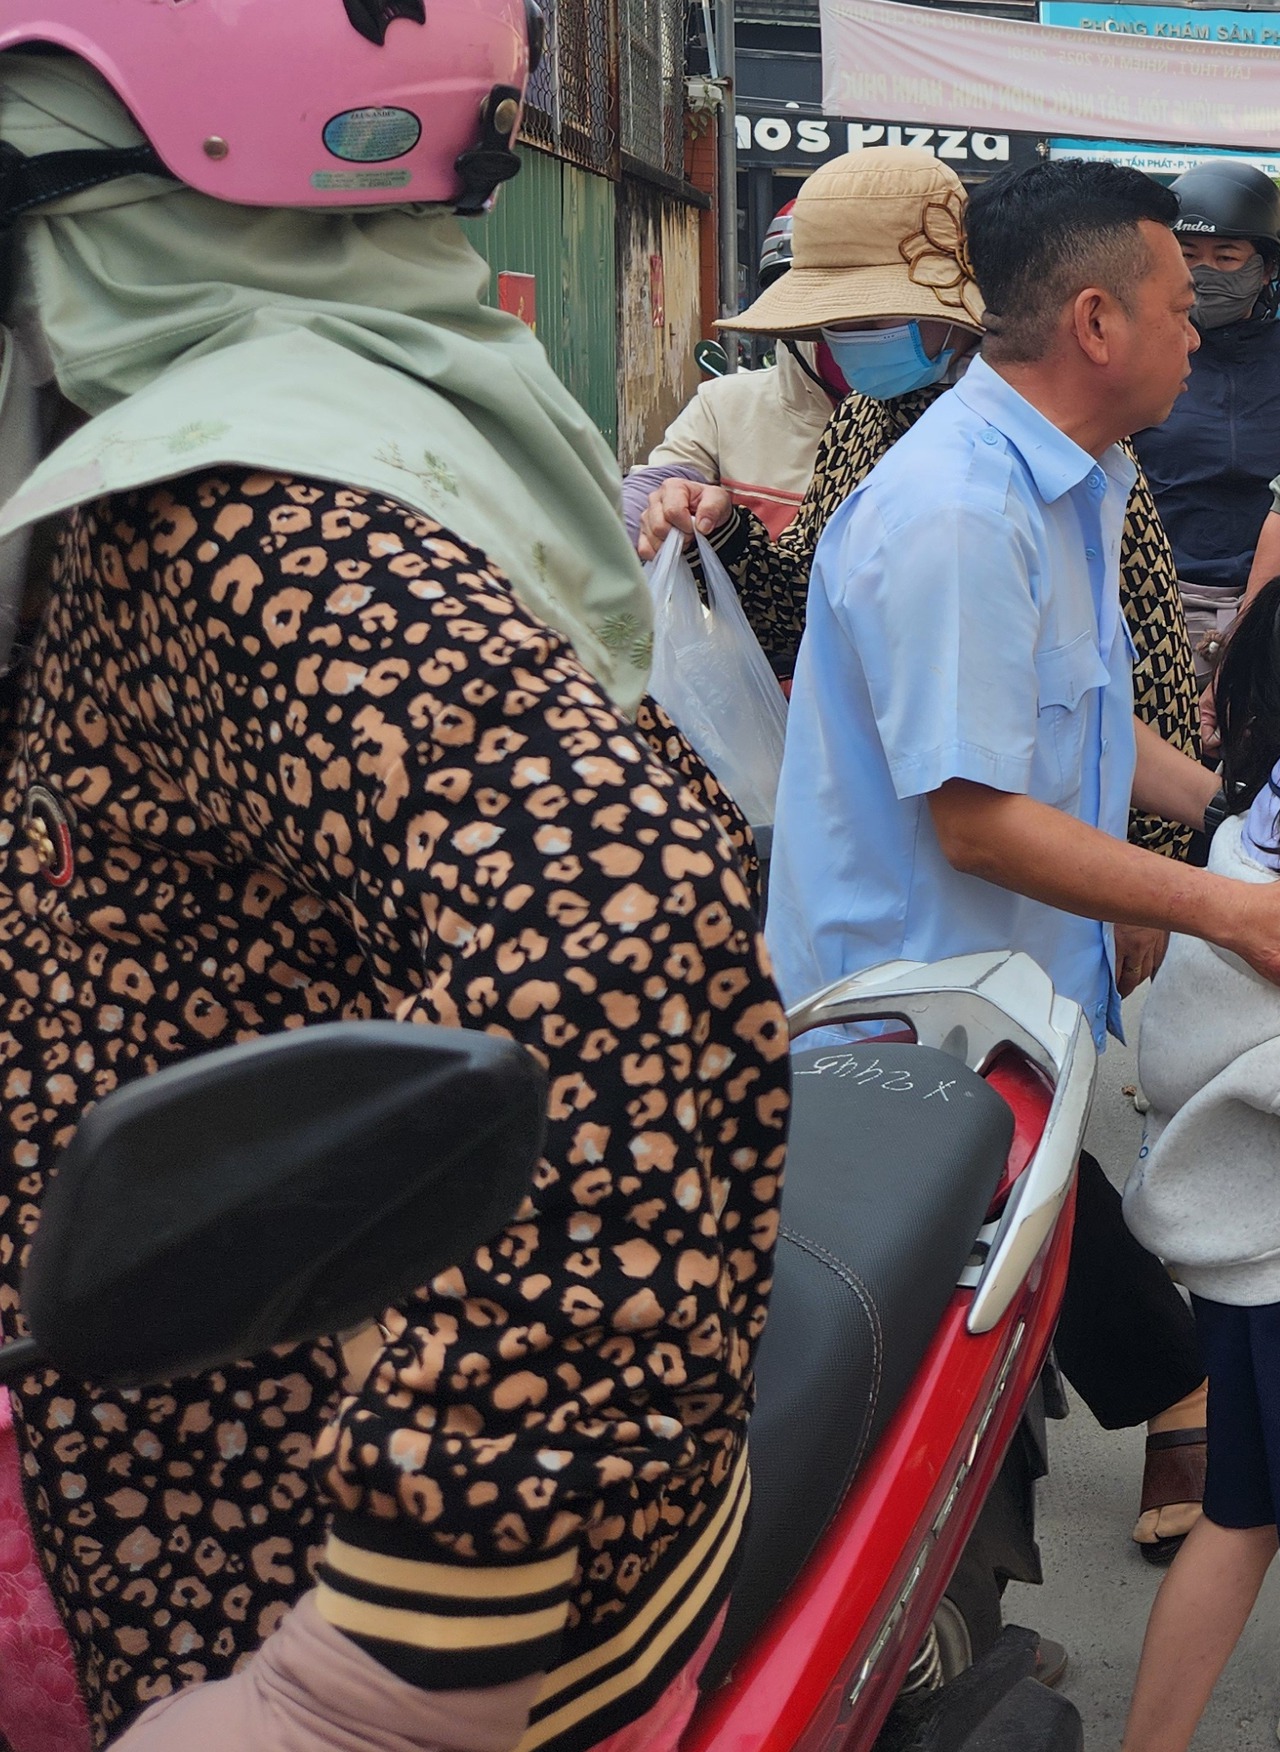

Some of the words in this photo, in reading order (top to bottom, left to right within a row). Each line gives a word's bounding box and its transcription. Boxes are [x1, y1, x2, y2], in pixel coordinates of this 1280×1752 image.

[1080, 16, 1148, 36] PHÒNG
[1154, 21, 1211, 40] KHÁM
[1171, 219, 1216, 233] Andes
